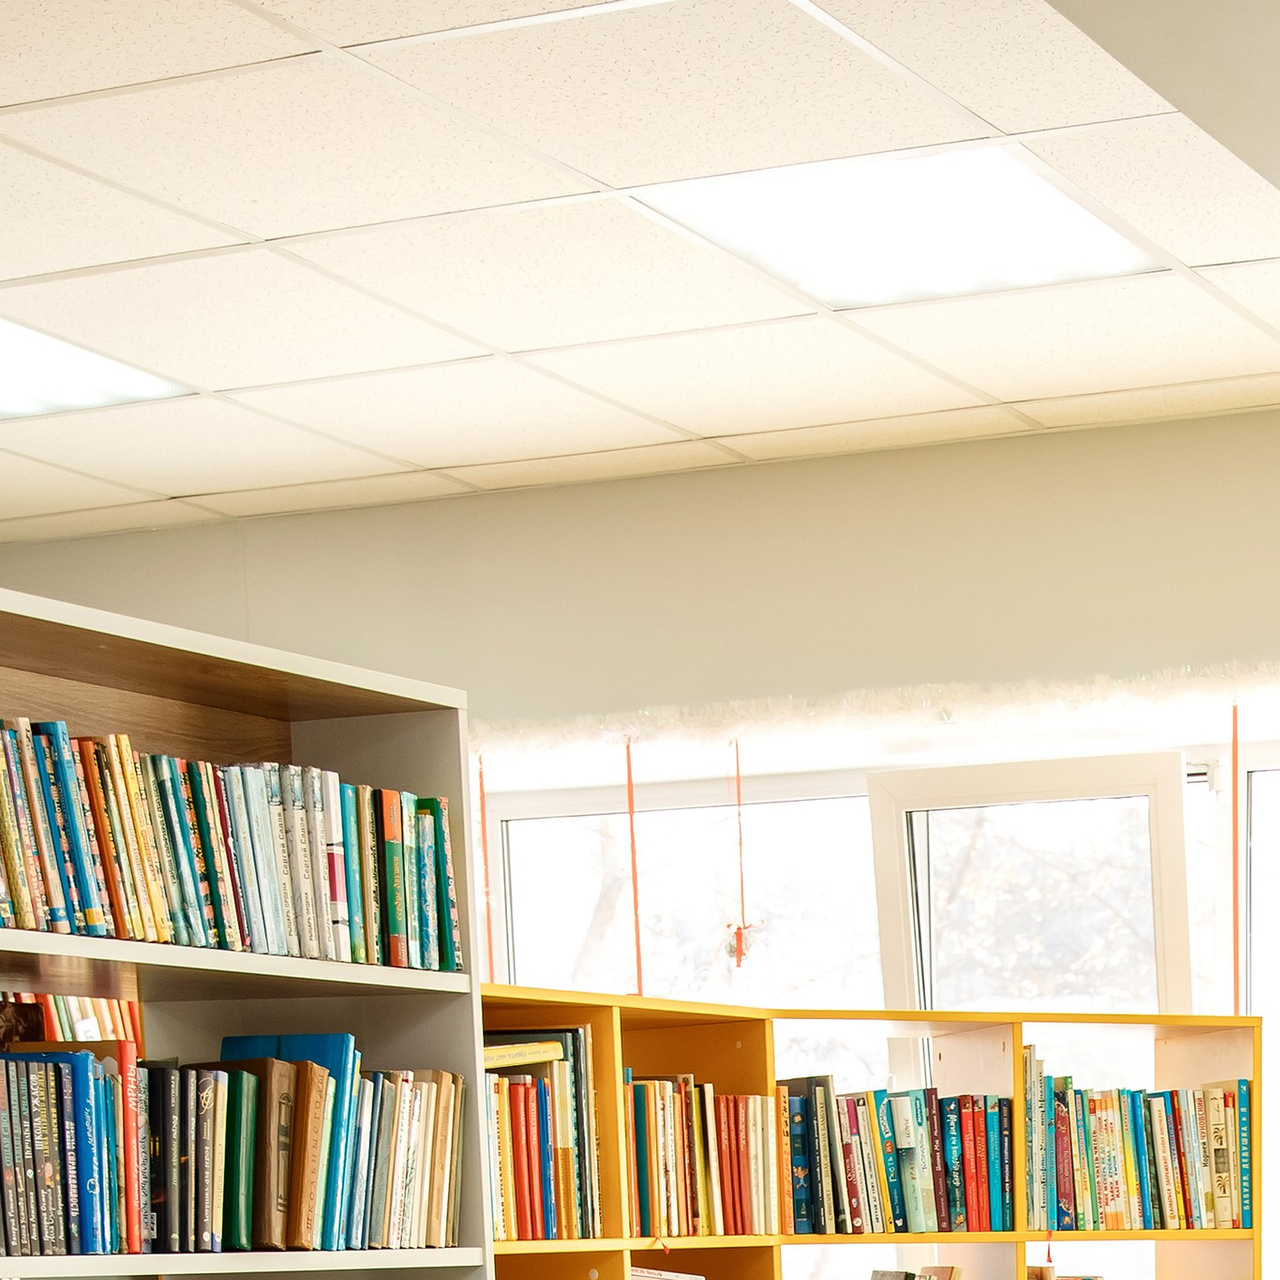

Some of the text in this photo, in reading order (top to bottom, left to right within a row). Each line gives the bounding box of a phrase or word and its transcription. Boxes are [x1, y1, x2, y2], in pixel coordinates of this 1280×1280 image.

[276, 812, 289, 875] Сергей Садов
[299, 817, 310, 880] Сергей Садов
[282, 882, 290, 908] ОРДЕНА
[30, 1074, 43, 1149] ШКОЛА УЖАСОВ
[1197, 1097, 1209, 1167] Корней ЧУКОВСКИЙ
[1241, 1126, 1249, 1169] ДЕДУШКА
